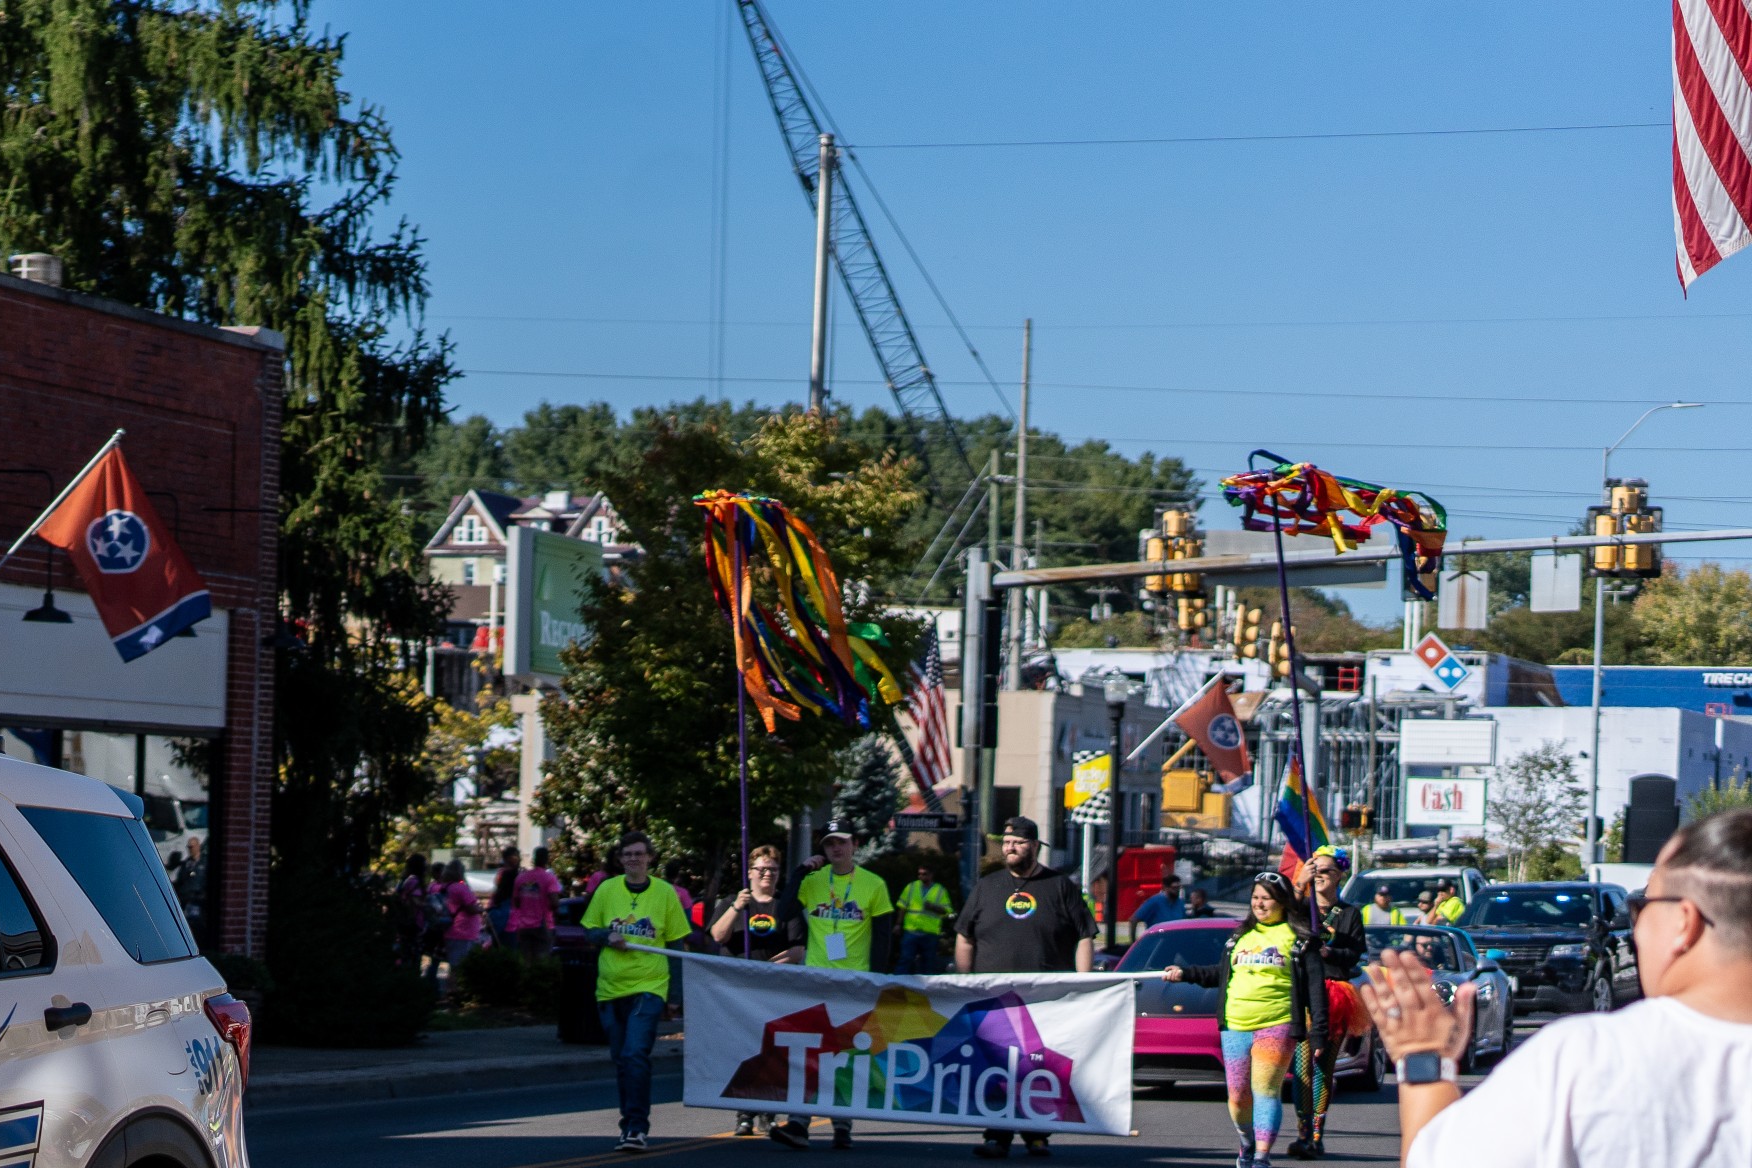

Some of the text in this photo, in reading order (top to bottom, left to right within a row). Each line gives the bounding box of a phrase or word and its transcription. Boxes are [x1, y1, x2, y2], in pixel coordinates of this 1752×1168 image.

[1420, 782, 1464, 811] Cash
[1237, 952, 1283, 967] TriPride
[774, 1031, 1061, 1122] TriPride
